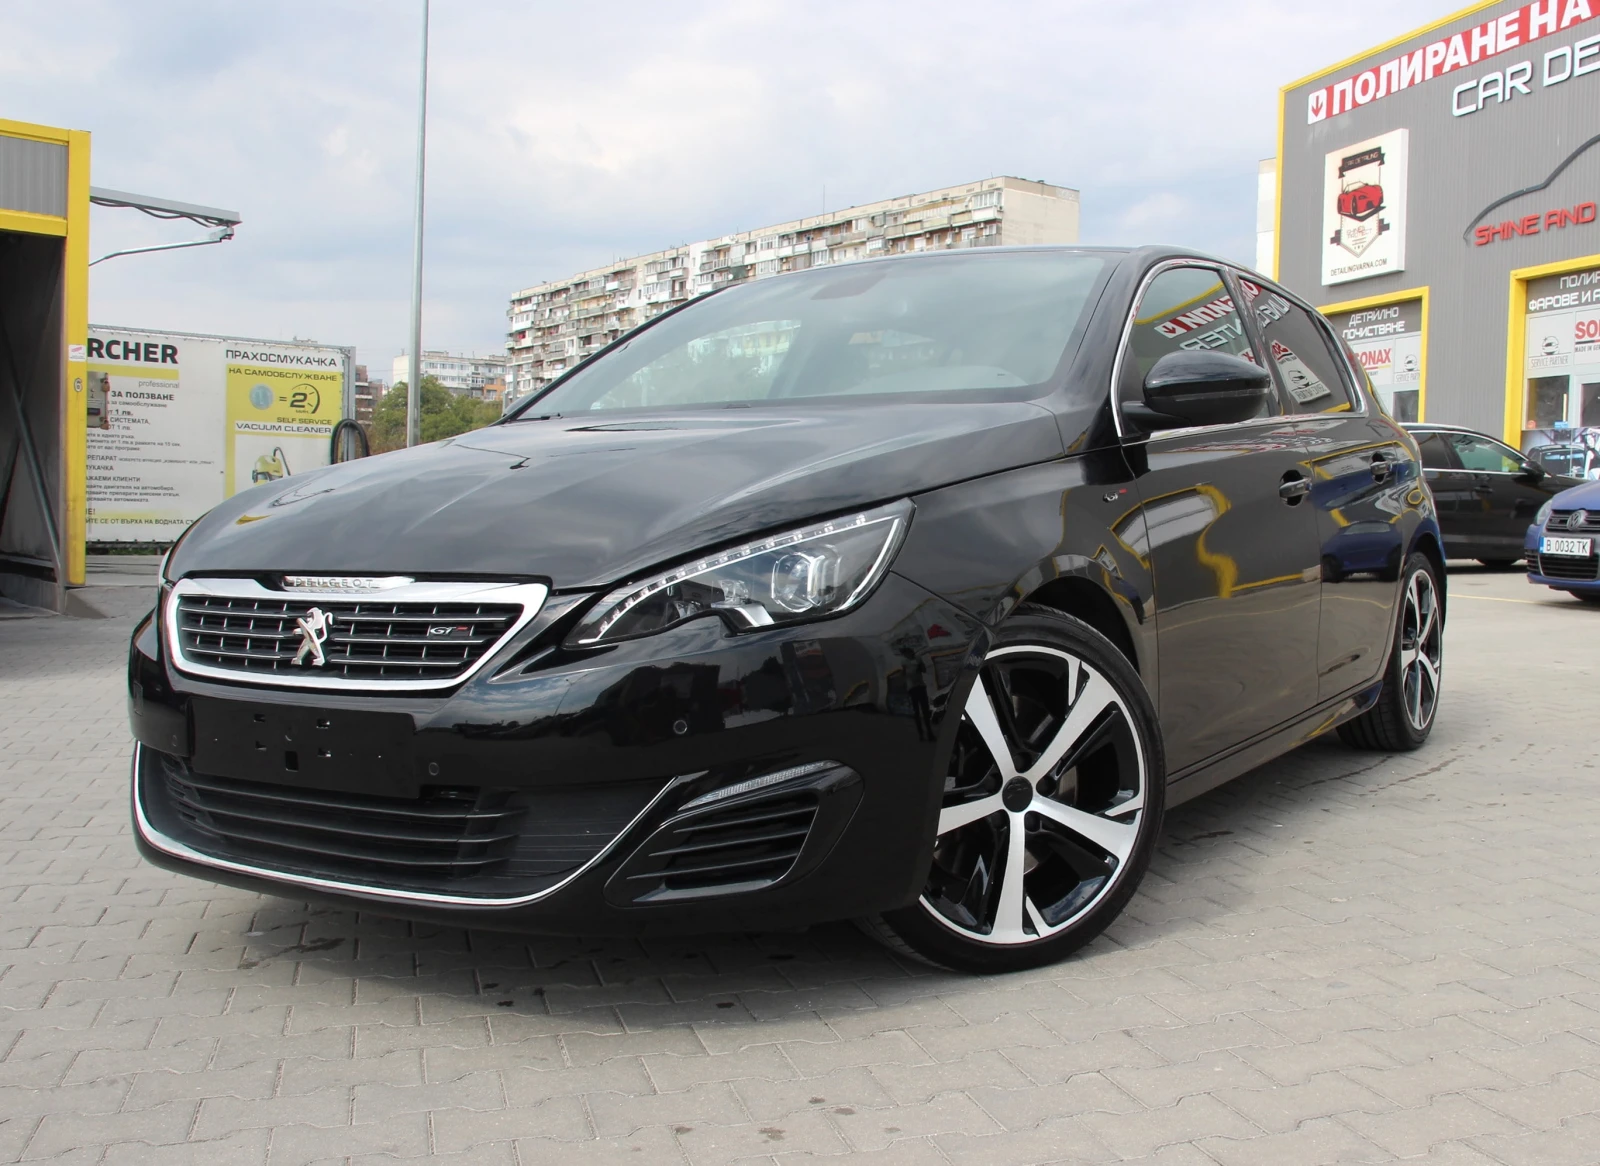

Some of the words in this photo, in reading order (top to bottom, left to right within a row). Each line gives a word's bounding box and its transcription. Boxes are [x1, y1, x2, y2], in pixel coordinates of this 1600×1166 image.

[1333, 10, 1520, 116] ПОЛИРАНЕ
[1529, 0, 1592, 40] НА
[1452, 60, 1533, 117] CAR
[1543, 33, 1600, 87] DE
[1474, 213, 1540, 247] SHINE
[1544, 201, 1597, 231] AND
[1330, 258, 1388, 276] DETAILINGVARNA.COM
[1529, 292, 1580, 312] ФАРОВЕ
[1582, 289, 1591, 304] И
[1348, 306, 1400, 328] ДЕТАЙЛНО
[1342, 320, 1406, 340] ПОЧИСТВАНЕ
[1575, 319, 1600, 340] SO
[226, 349, 337, 367] ПРАХОСМУКАЧКА
[1531, 357, 1549, 369] SERVICE
[1549, 354, 1569, 366] PARTNER
[244, 368, 338, 382] САМООБСЛУЖВАНЕ
[138, 380, 180, 389] professional
[111, 390, 123, 398] ЗА
[125, 391, 175, 401] ПОЛЗВАНЕ
[290, 392, 308, 408] 2
[110, 416, 151, 425] СИСТЕМАТА,
[236, 422, 282, 432] VACUUM
[284, 425, 332, 434] CLEANER
[298, 418, 333, 426] SERVICE
[1546, 539, 1552, 552] B
[1554, 540, 1575, 554] 0032
[1576, 540, 1588, 554] TK
[293, 577, 374, 588] PEUGEOT
[430, 626, 457, 635] GT
